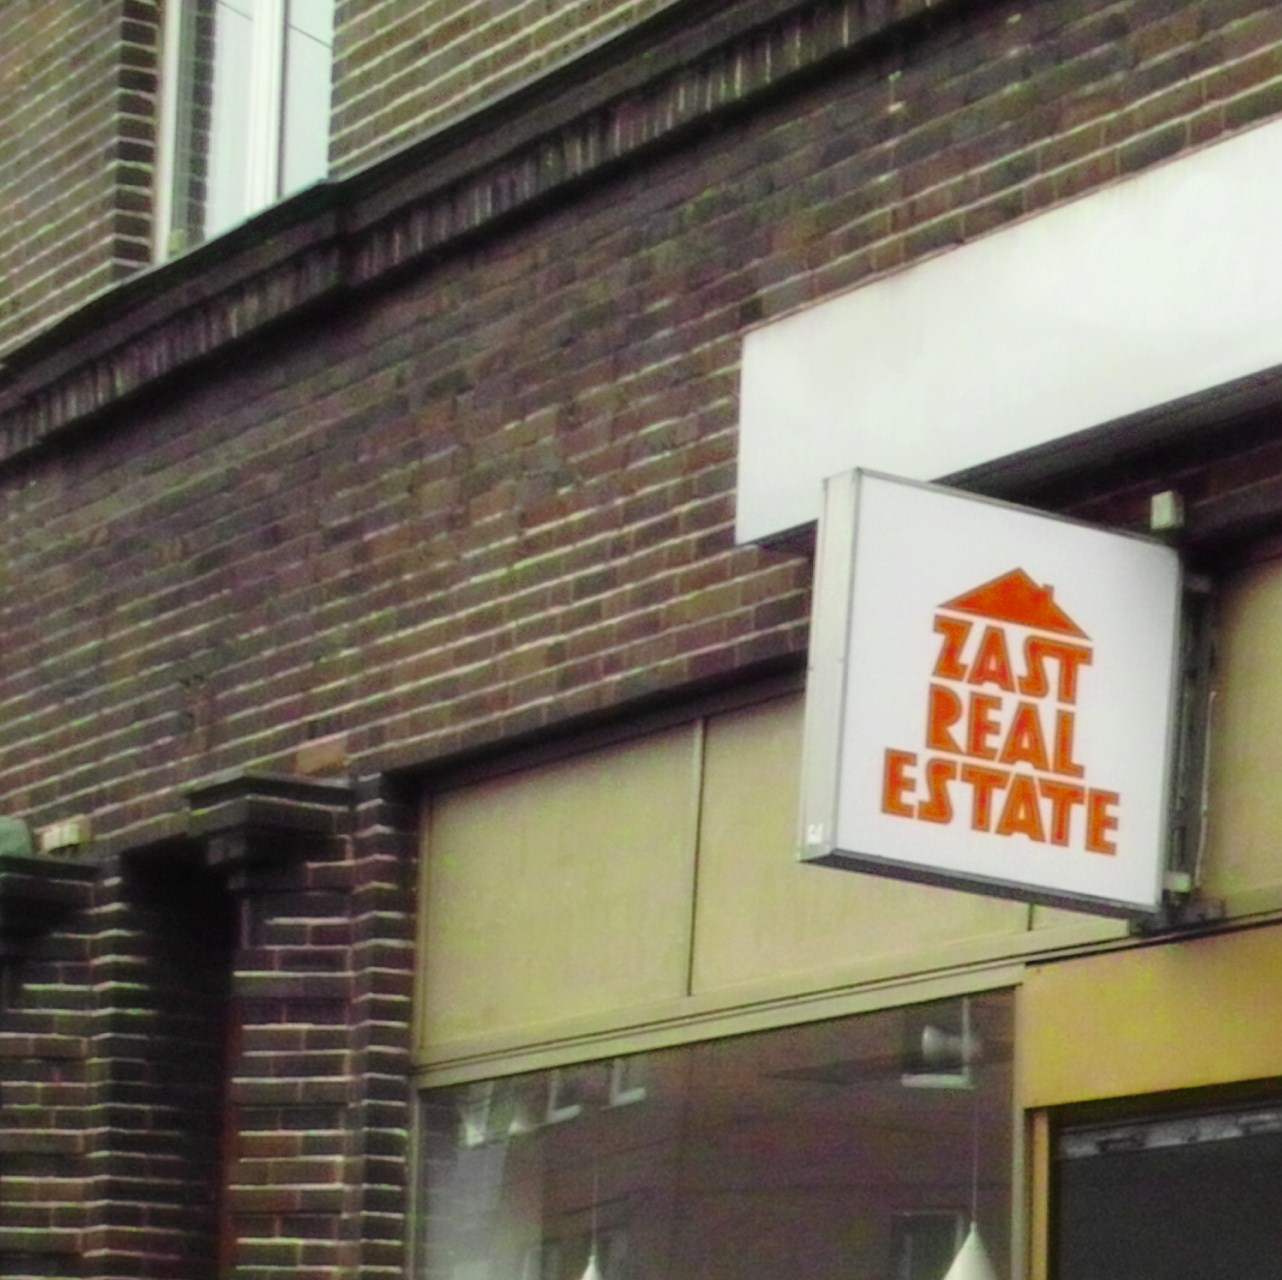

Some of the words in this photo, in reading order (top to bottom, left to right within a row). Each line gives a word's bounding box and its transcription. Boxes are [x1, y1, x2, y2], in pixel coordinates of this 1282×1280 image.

[932, 614, 1093, 704] ZAST
[925, 683, 1085, 778] REAL
[881, 747, 1120, 857] ESTATE
